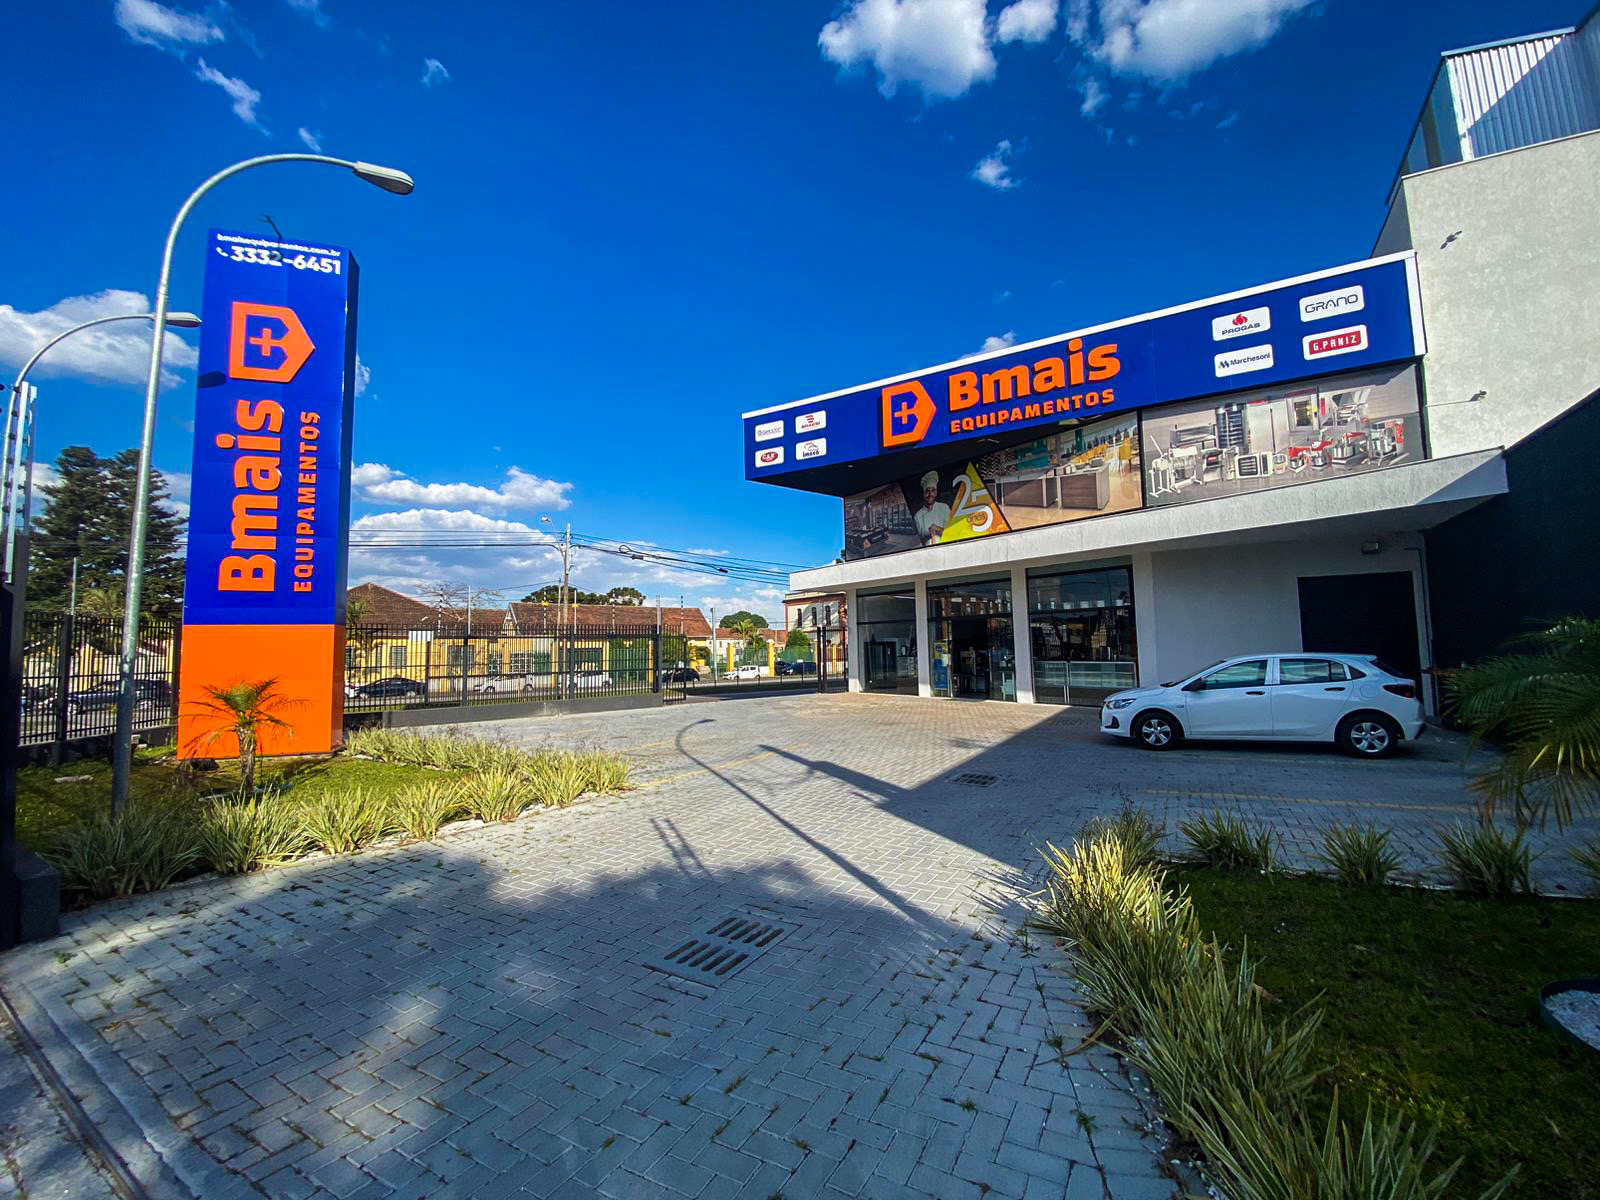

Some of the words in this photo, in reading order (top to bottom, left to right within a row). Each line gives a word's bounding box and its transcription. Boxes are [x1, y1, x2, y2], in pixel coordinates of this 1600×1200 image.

[230, 245, 341, 275] 3332-6451
[1304, 293, 1359, 314] GRANO
[1230, 352, 1271, 366] Marchesoni
[1312, 334, 1358, 351] G.PANIZ
[949, 338, 1121, 412] Bmais
[950, 388, 1115, 434] EQUIPAMENTOS
[216, 399, 285, 593] Bmais
[294, 411, 321, 593] EQUIPAMENTOS
[952, 474, 993, 533] 25
